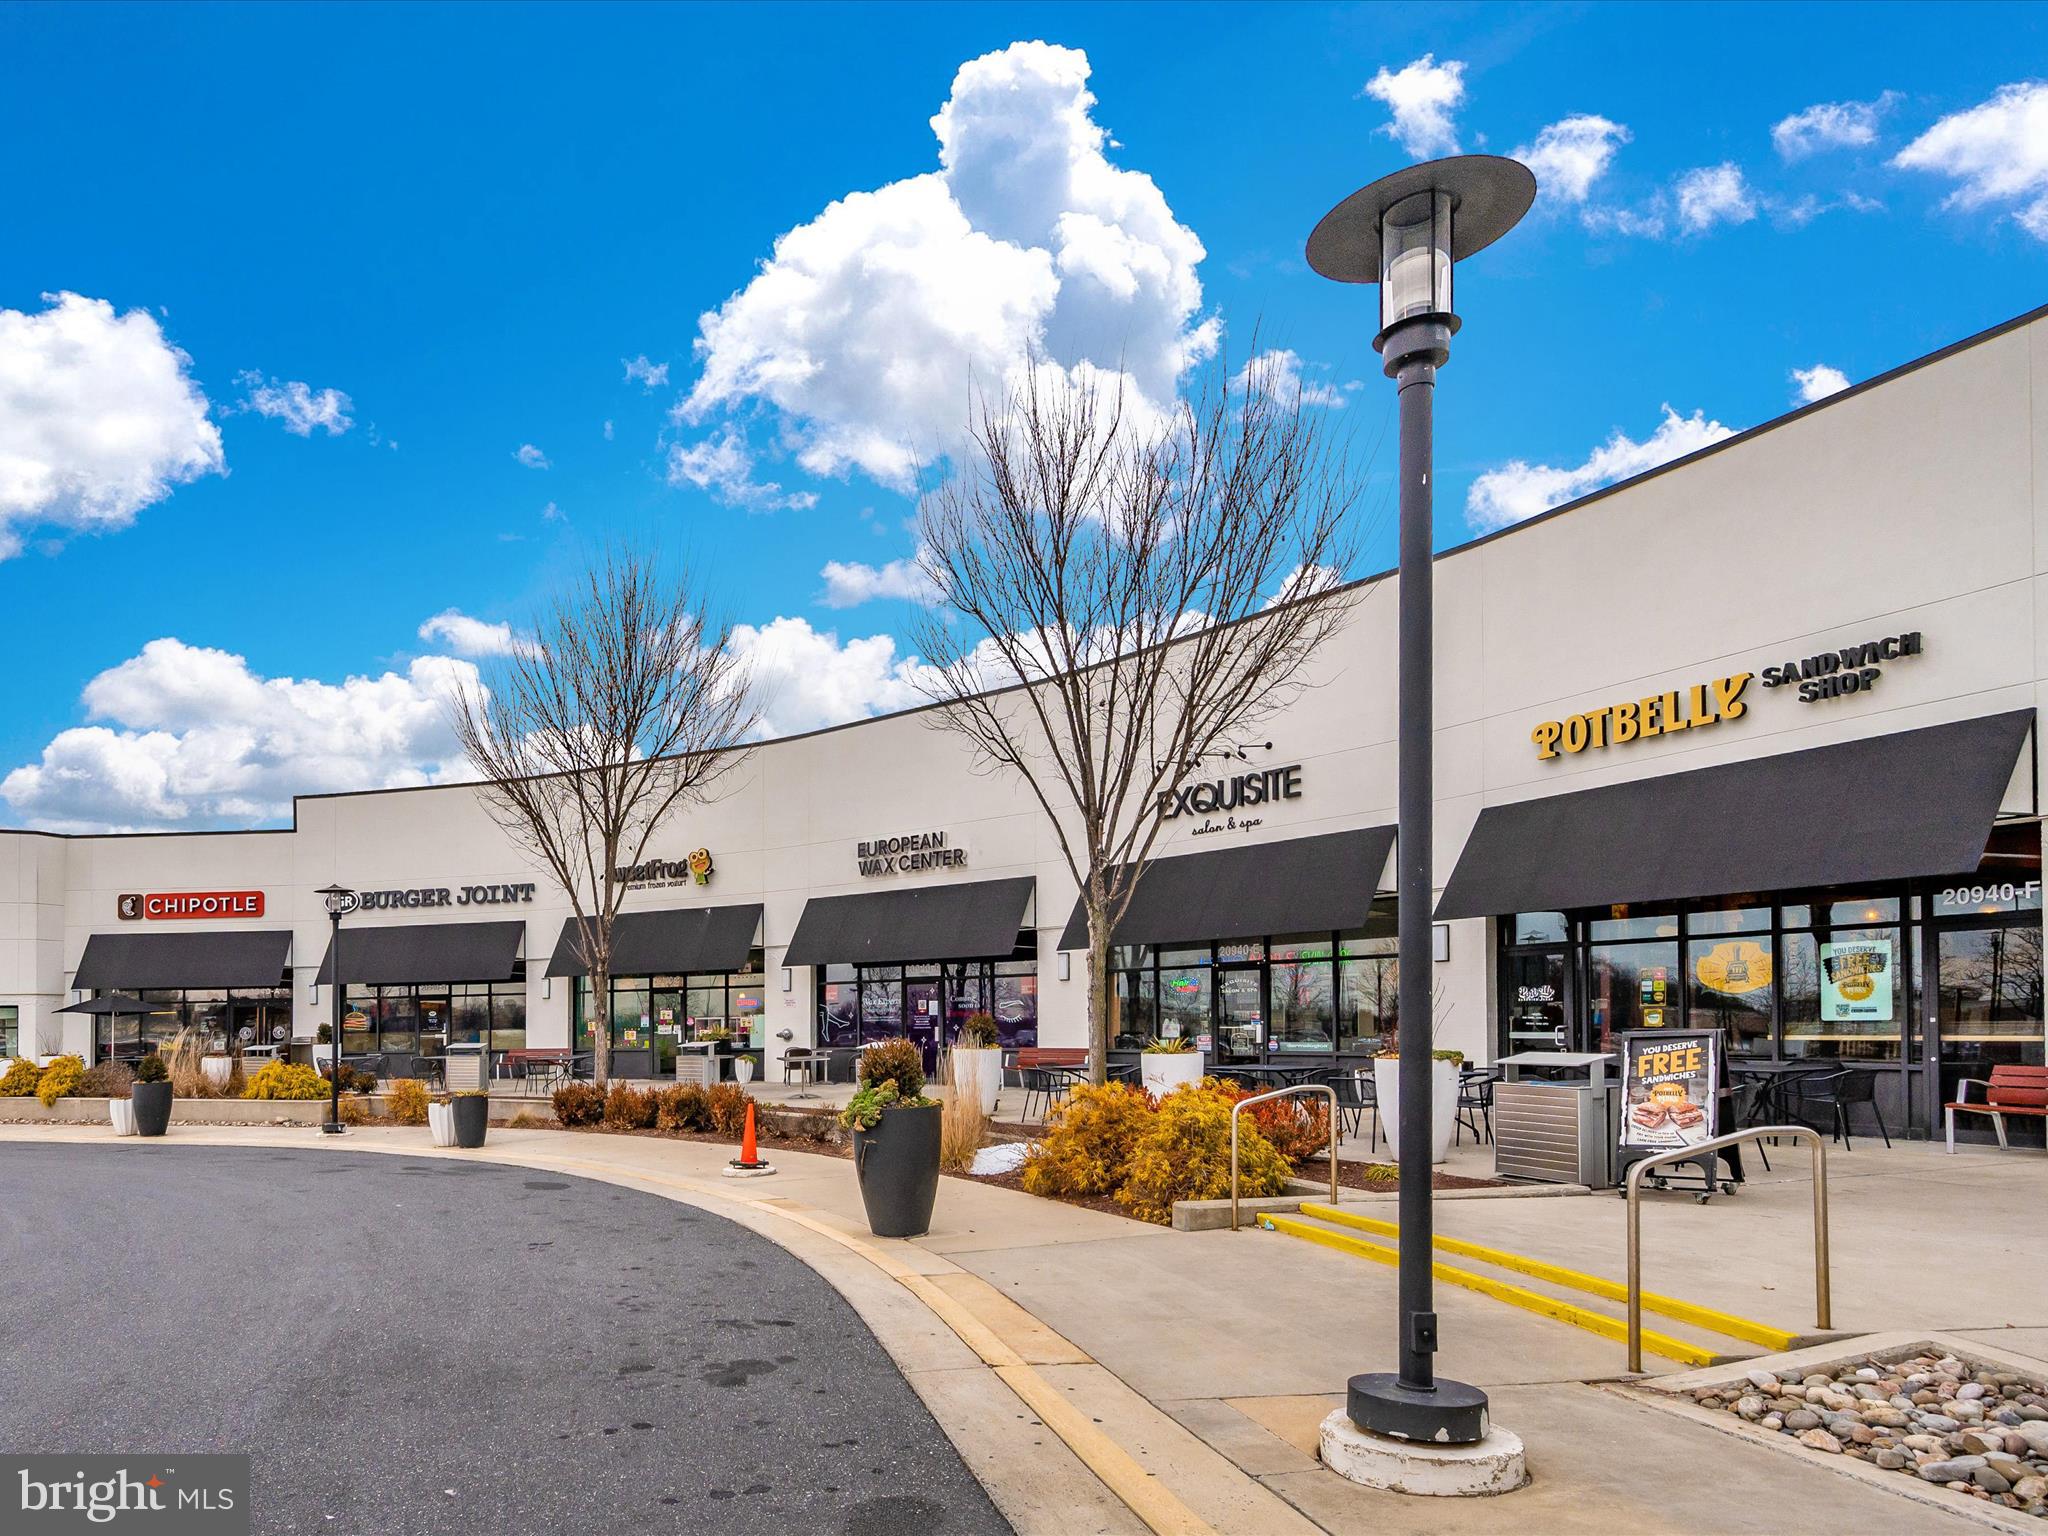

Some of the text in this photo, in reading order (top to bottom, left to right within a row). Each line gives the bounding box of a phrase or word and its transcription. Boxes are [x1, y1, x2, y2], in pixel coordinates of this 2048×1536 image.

[1762, 632, 1922, 688] SANDWICH
[1798, 667, 1882, 703] SHOP
[1531, 672, 1755, 761] POTBELLY
[1157, 764, 1302, 820] EXQUISITE
[1191, 817, 1263, 836] salon & spa
[857, 831, 946, 859] EUROPEAN
[858, 848, 965, 876] WAX CENTER
[148, 896, 257, 914] CHIPOTLE
[360, 888, 451, 910] BURGER
[457, 883, 535, 905] JOINT
[1942, 881, 2041, 906] 20940-F
[1839, 953, 1870, 969] FREE
[1642, 1040, 1698, 1056] YOU DESERVE
[1638, 1047, 1702, 1078] FREE
[1641, 1070, 1697, 1085] SANDWICHES
